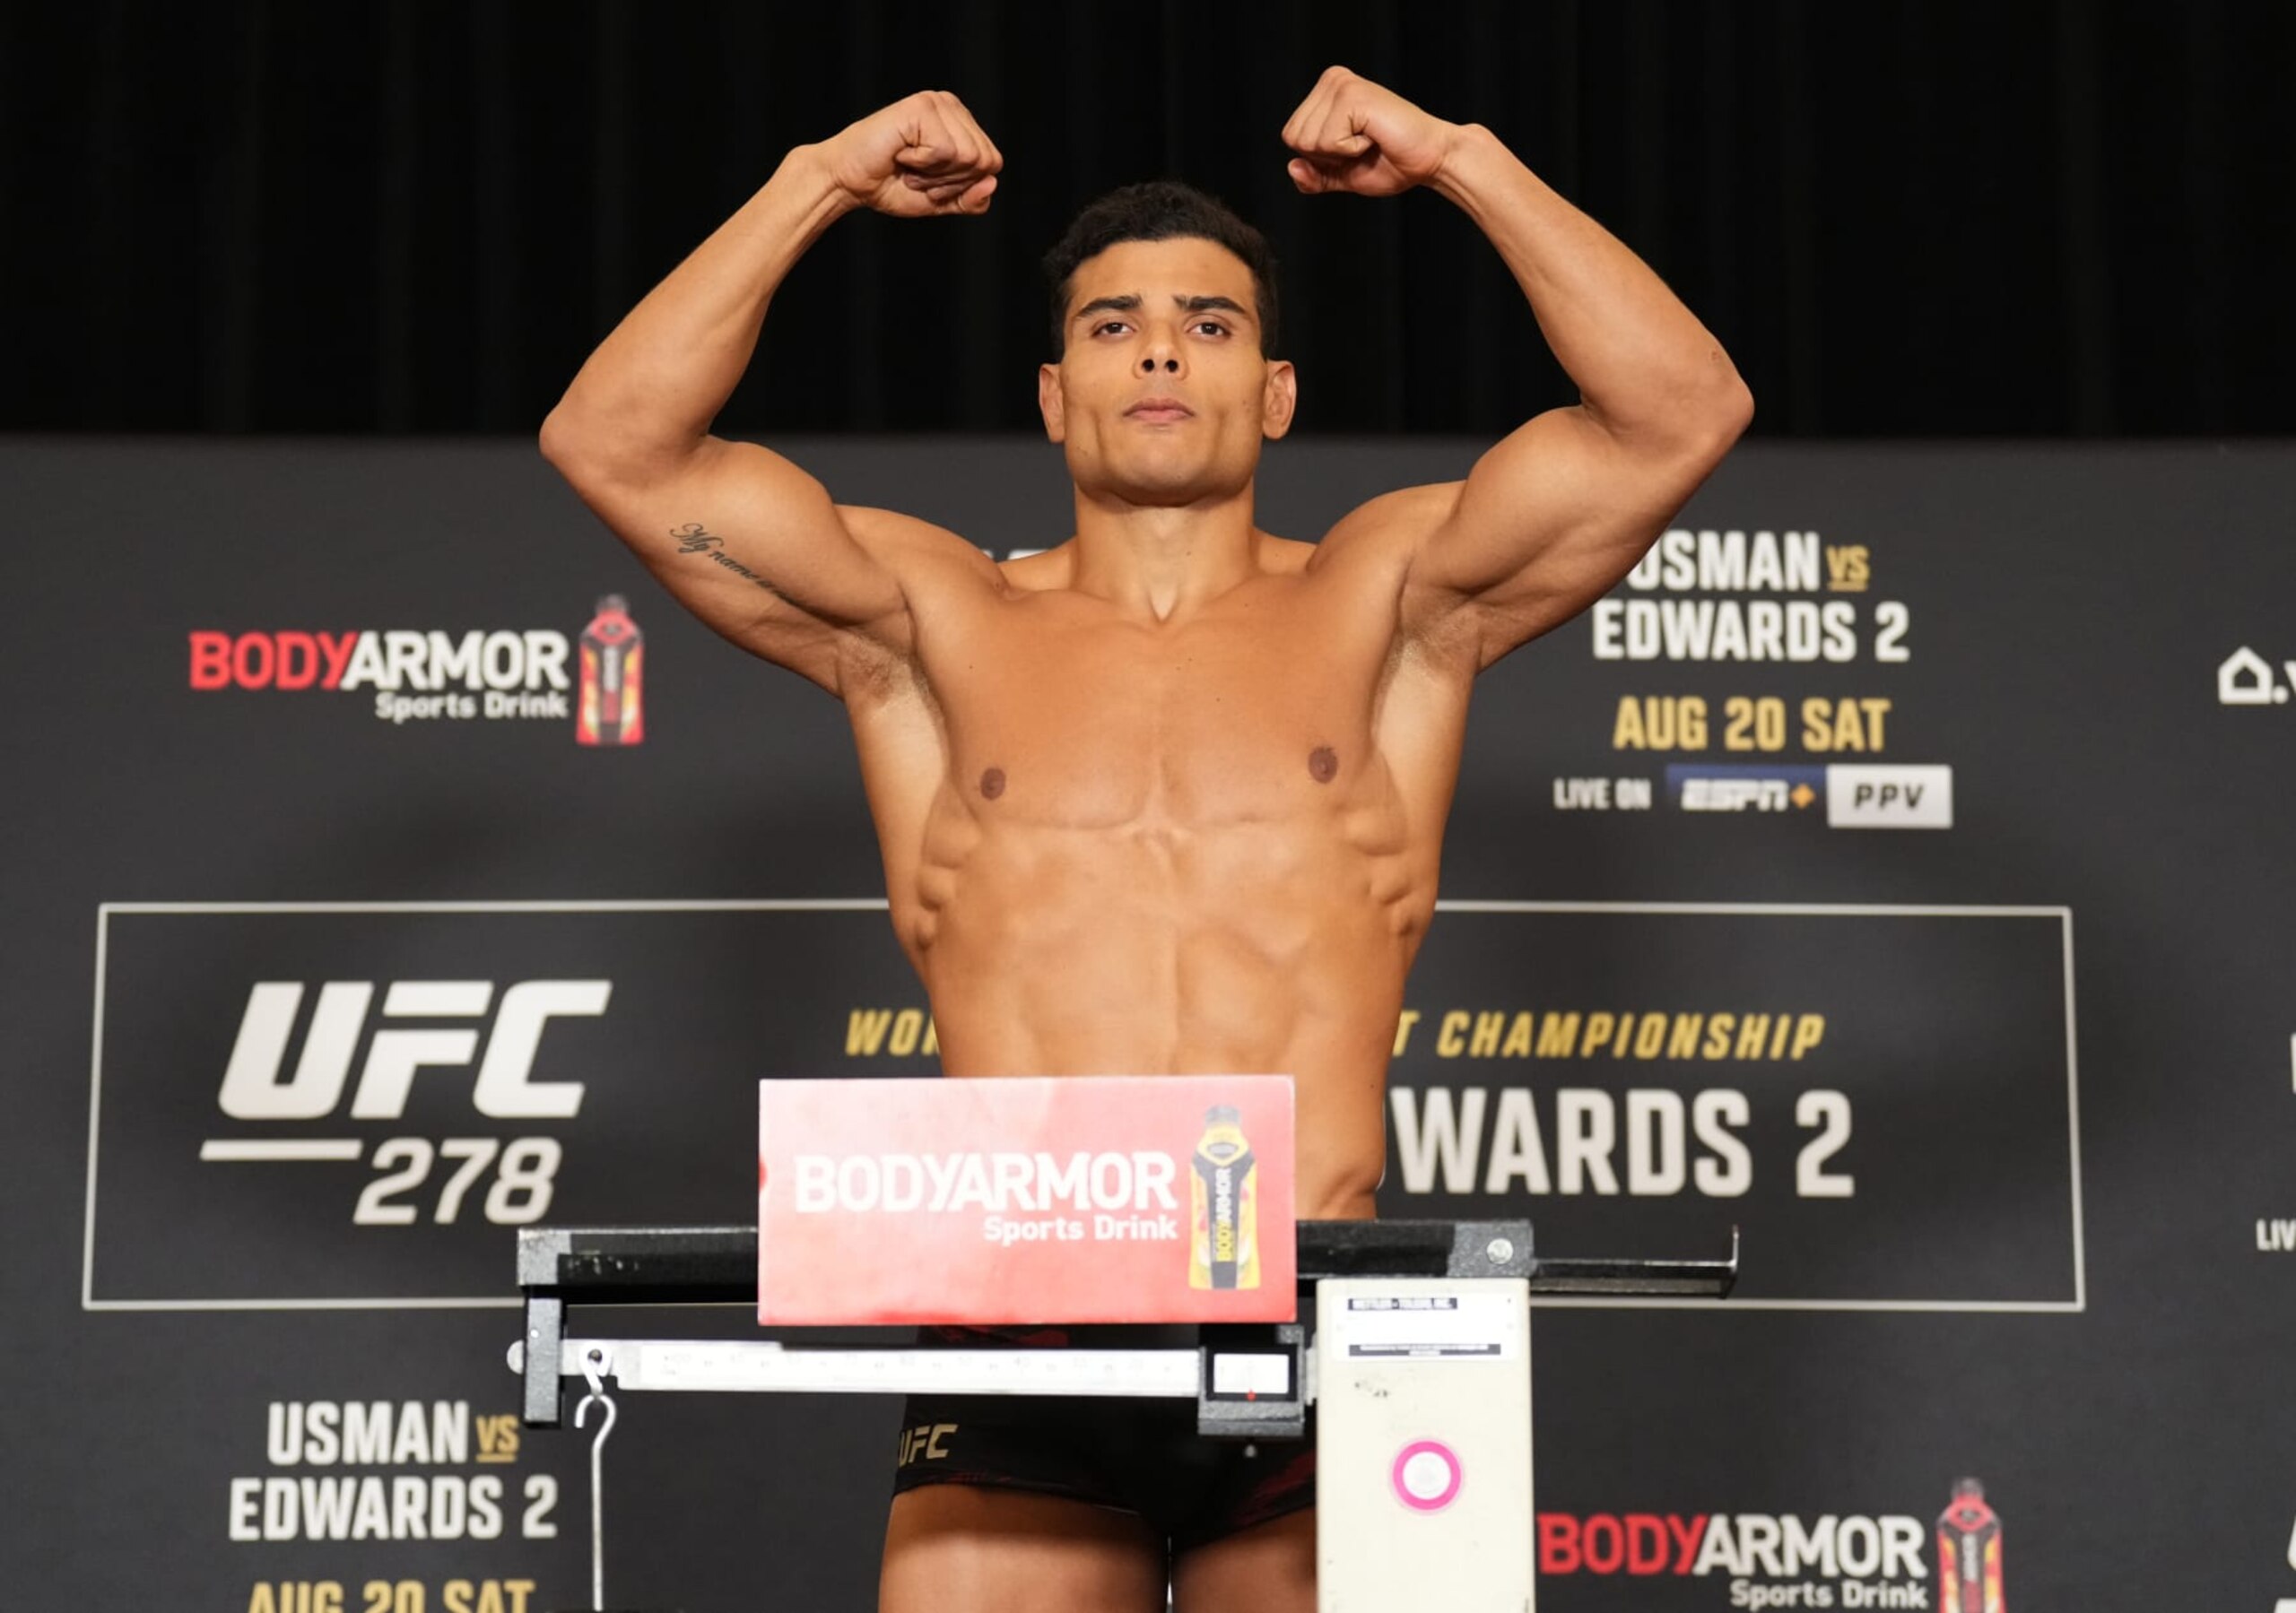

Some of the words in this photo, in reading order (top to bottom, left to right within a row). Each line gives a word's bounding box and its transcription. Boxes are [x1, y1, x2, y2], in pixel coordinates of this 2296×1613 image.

[669, 522, 725, 553] My
[1626, 529, 1820, 591] USMAN
[1827, 546, 1869, 591] VS
[188, 629, 570, 690] BODYARMOR
[1593, 600, 1857, 661] EDWARDS
[1874, 602, 1910, 662] 2
[376, 691, 477, 724] Sports
[484, 690, 570, 718] Drink
[1613, 697, 1708, 750] AUG
[1725, 698, 1786, 750] 20
[1802, 698, 1892, 750] SAT
[1554, 779, 1609, 809] LIVE
[1616, 779, 1651, 809] ON
[1854, 785, 1923, 809] PPV
[219, 980, 613, 1119] UFC
[1437, 1010, 1825, 1060] CHAMPIONSHIP
[1390, 1087, 1752, 1197] WARDS
[1796, 1089, 1854, 1197] 2
[352, 1137, 561, 1225] 278
[794, 1151, 1179, 1213] BODYARMOR
[984, 1215, 1084, 1246] Sports
[1093, 1214, 1179, 1241] Drink
[268, 1401, 469, 1466] USMAN
[476, 1416, 519, 1463] VS
[899, 1423, 958, 1468] UFC
[229, 1476, 503, 1541] EDWARDS
[522, 1476, 557, 1539] 2
[1536, 1513, 1928, 1578] BODYARMOR
[248, 1581, 344, 1613] AUG
[363, 1580, 425, 1613] 20
[443, 1580, 535, 1613] SAT
[1730, 1579, 1833, 1612] Sports
[1841, 1579, 1928, 1609] Drink
